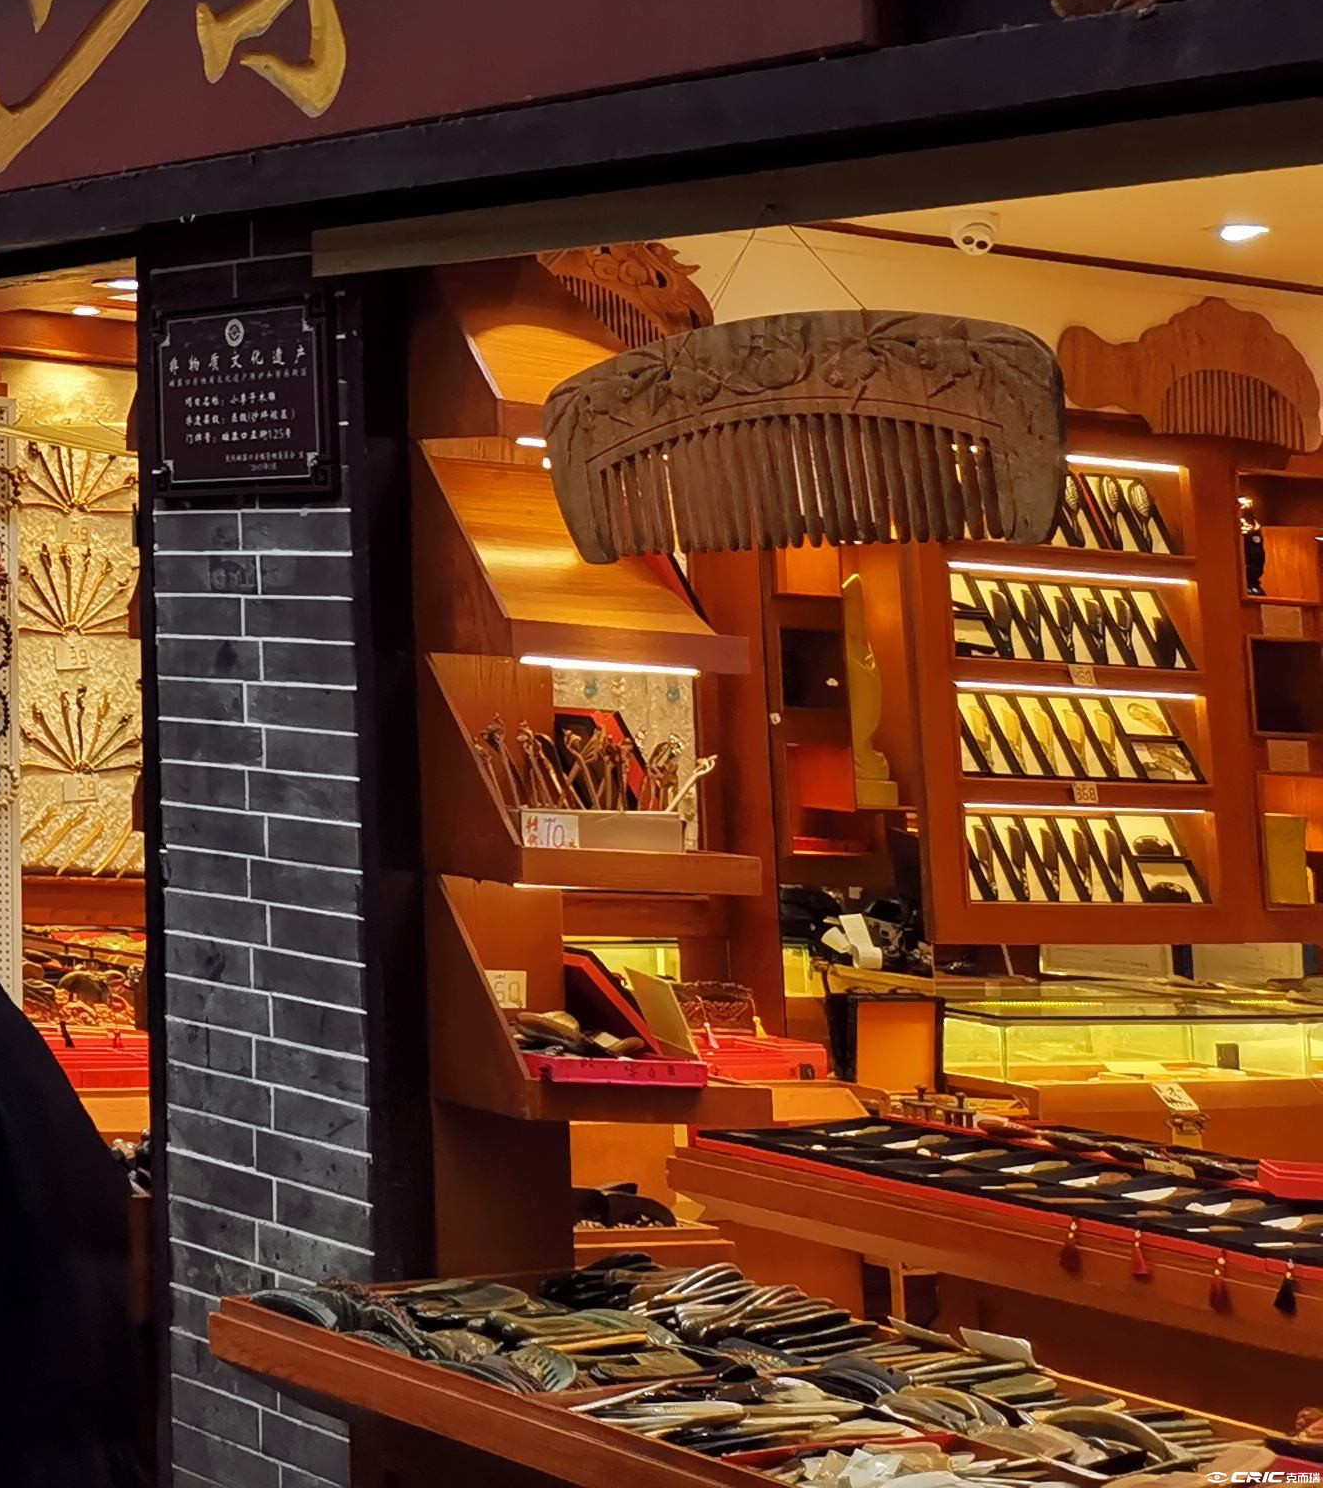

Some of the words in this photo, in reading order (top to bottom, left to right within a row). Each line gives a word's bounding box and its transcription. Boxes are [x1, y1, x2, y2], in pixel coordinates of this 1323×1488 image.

[168, 344, 306, 375] 非物质文化遗产
